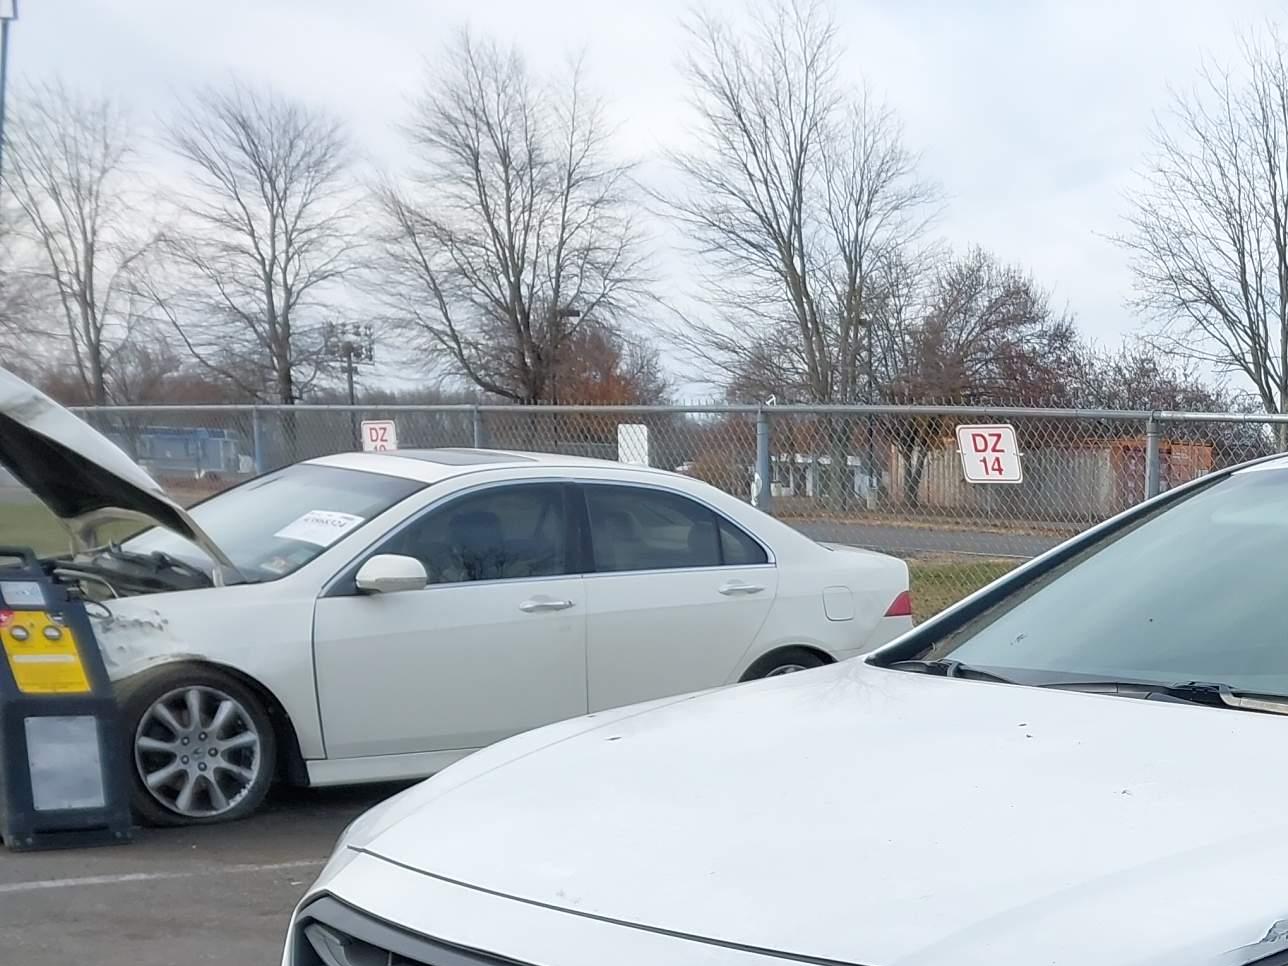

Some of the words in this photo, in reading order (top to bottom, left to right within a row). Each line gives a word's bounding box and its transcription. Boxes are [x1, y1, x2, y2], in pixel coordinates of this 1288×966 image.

[368, 427, 388, 442] DZ
[971, 432, 1006, 453] DZ
[979, 456, 1004, 476] 14
